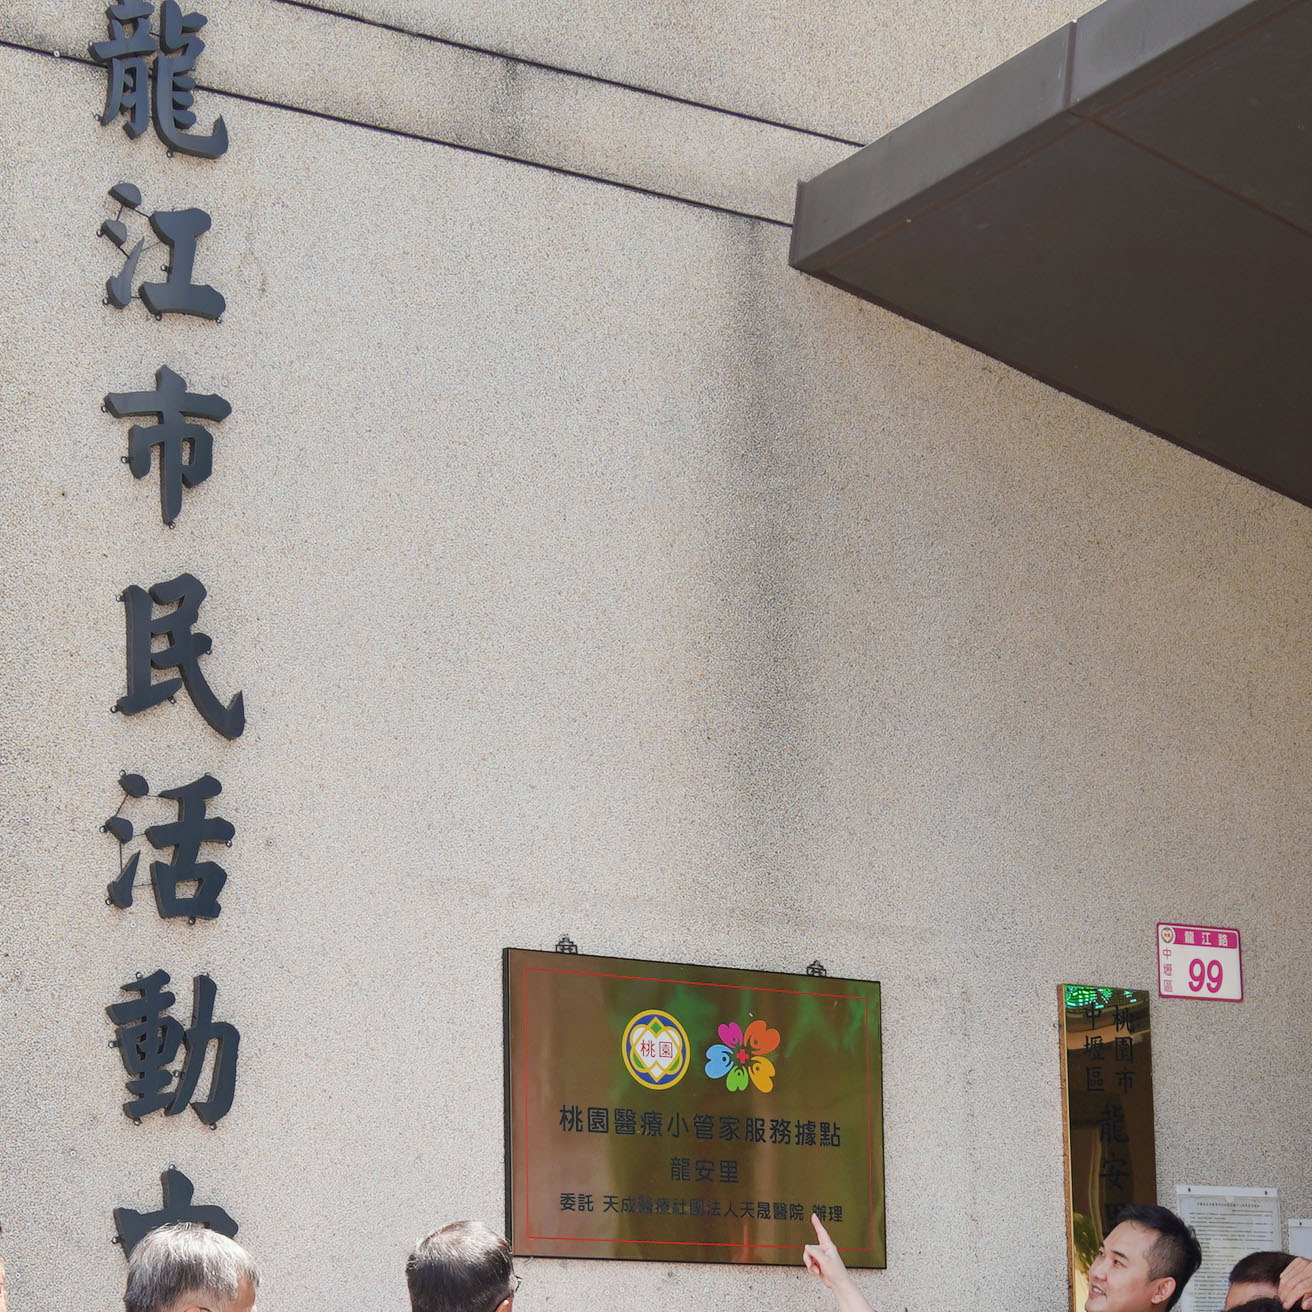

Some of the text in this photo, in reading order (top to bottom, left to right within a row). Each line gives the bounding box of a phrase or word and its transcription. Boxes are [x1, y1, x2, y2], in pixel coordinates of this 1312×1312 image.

[1183, 930, 1229, 947] 龍江路
[1188, 958, 1224, 994] 99
[640, 1039, 673, 1059] 桃園
[1112, 1004, 1136, 1096] 桃園市
[558, 1103, 842, 1148] 桃園醫療小管家服務據點
[670, 1156, 740, 1184] 龍安里
[559, 1192, 594, 1213] 委託
